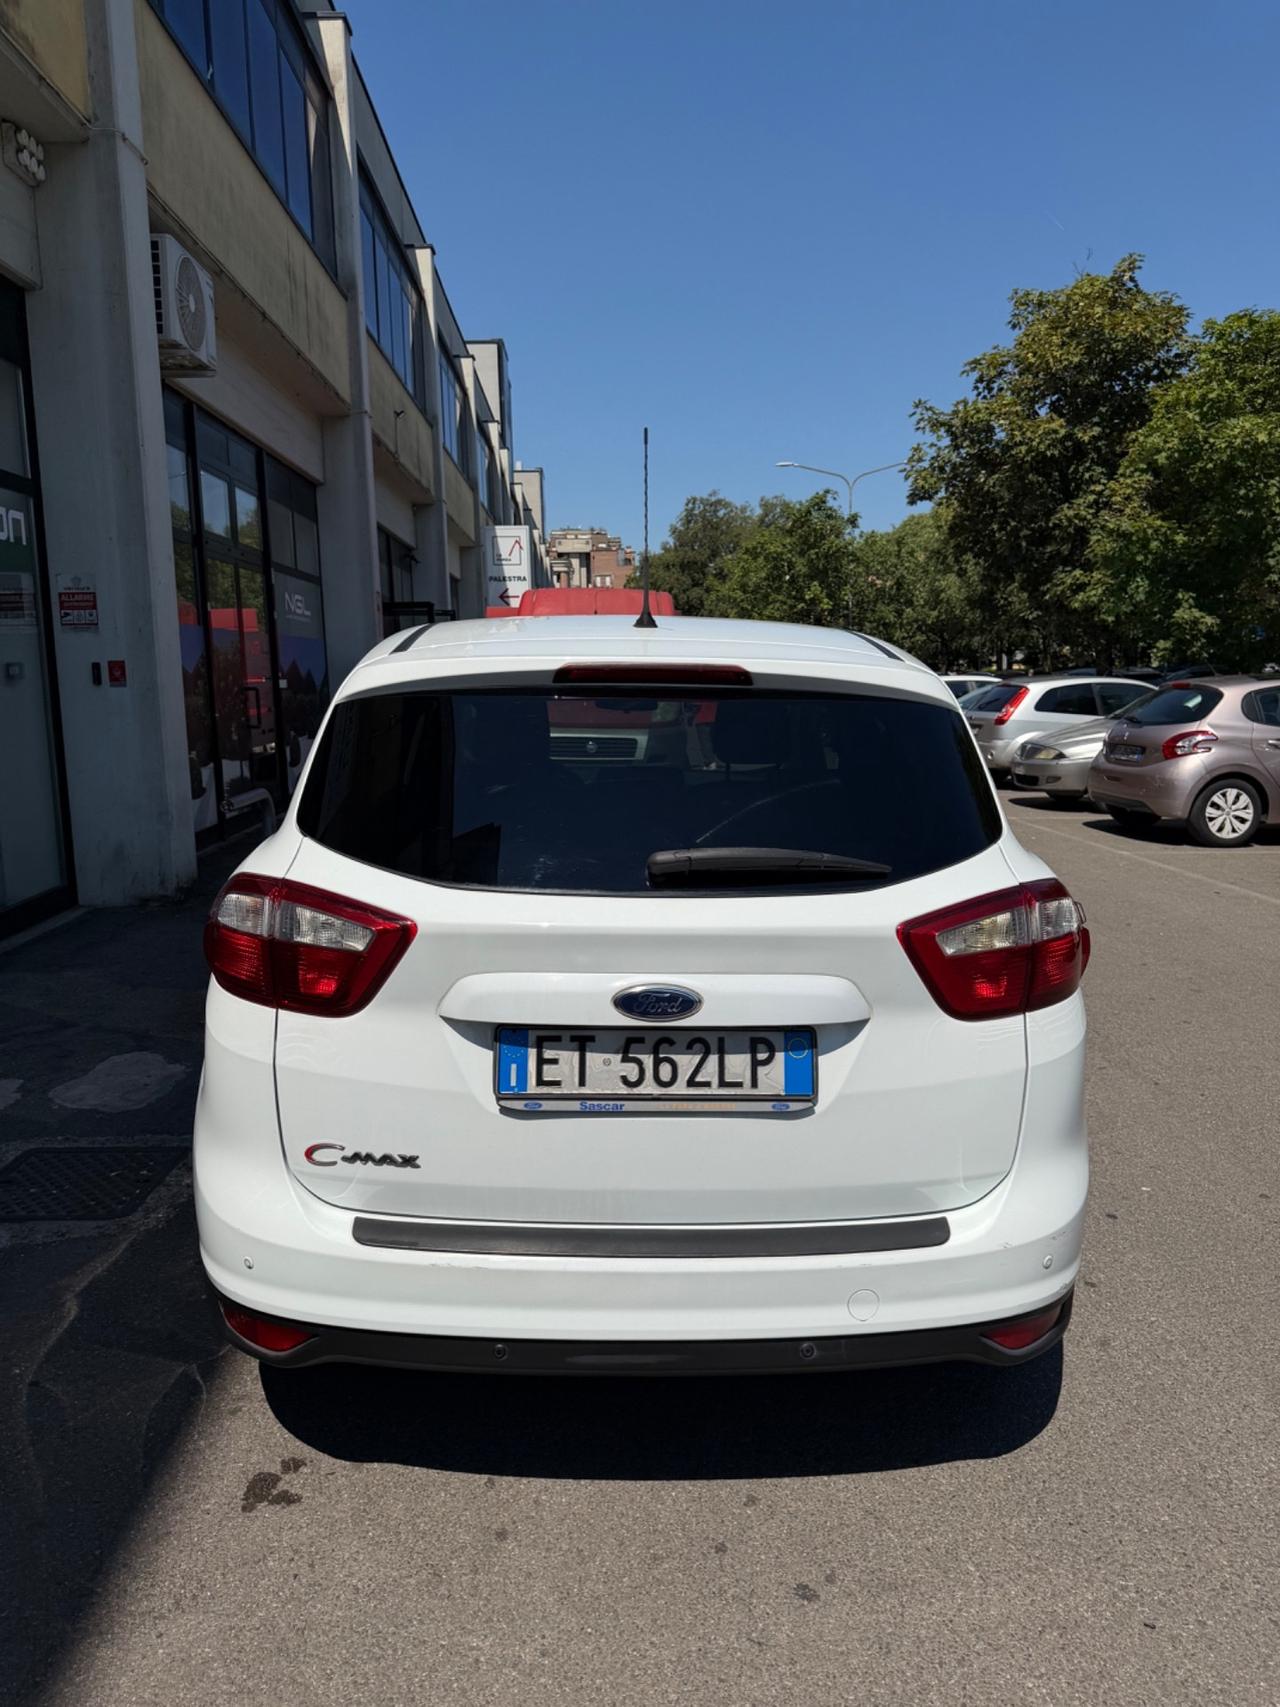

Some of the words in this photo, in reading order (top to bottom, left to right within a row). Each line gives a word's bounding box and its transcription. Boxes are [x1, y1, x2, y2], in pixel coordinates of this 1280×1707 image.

[633, 992, 683, 1013] Ford
[536, 1035, 596, 1088] ET
[619, 1036, 777, 1089] 562LP
[579, 1100, 625, 1111] Sascar
